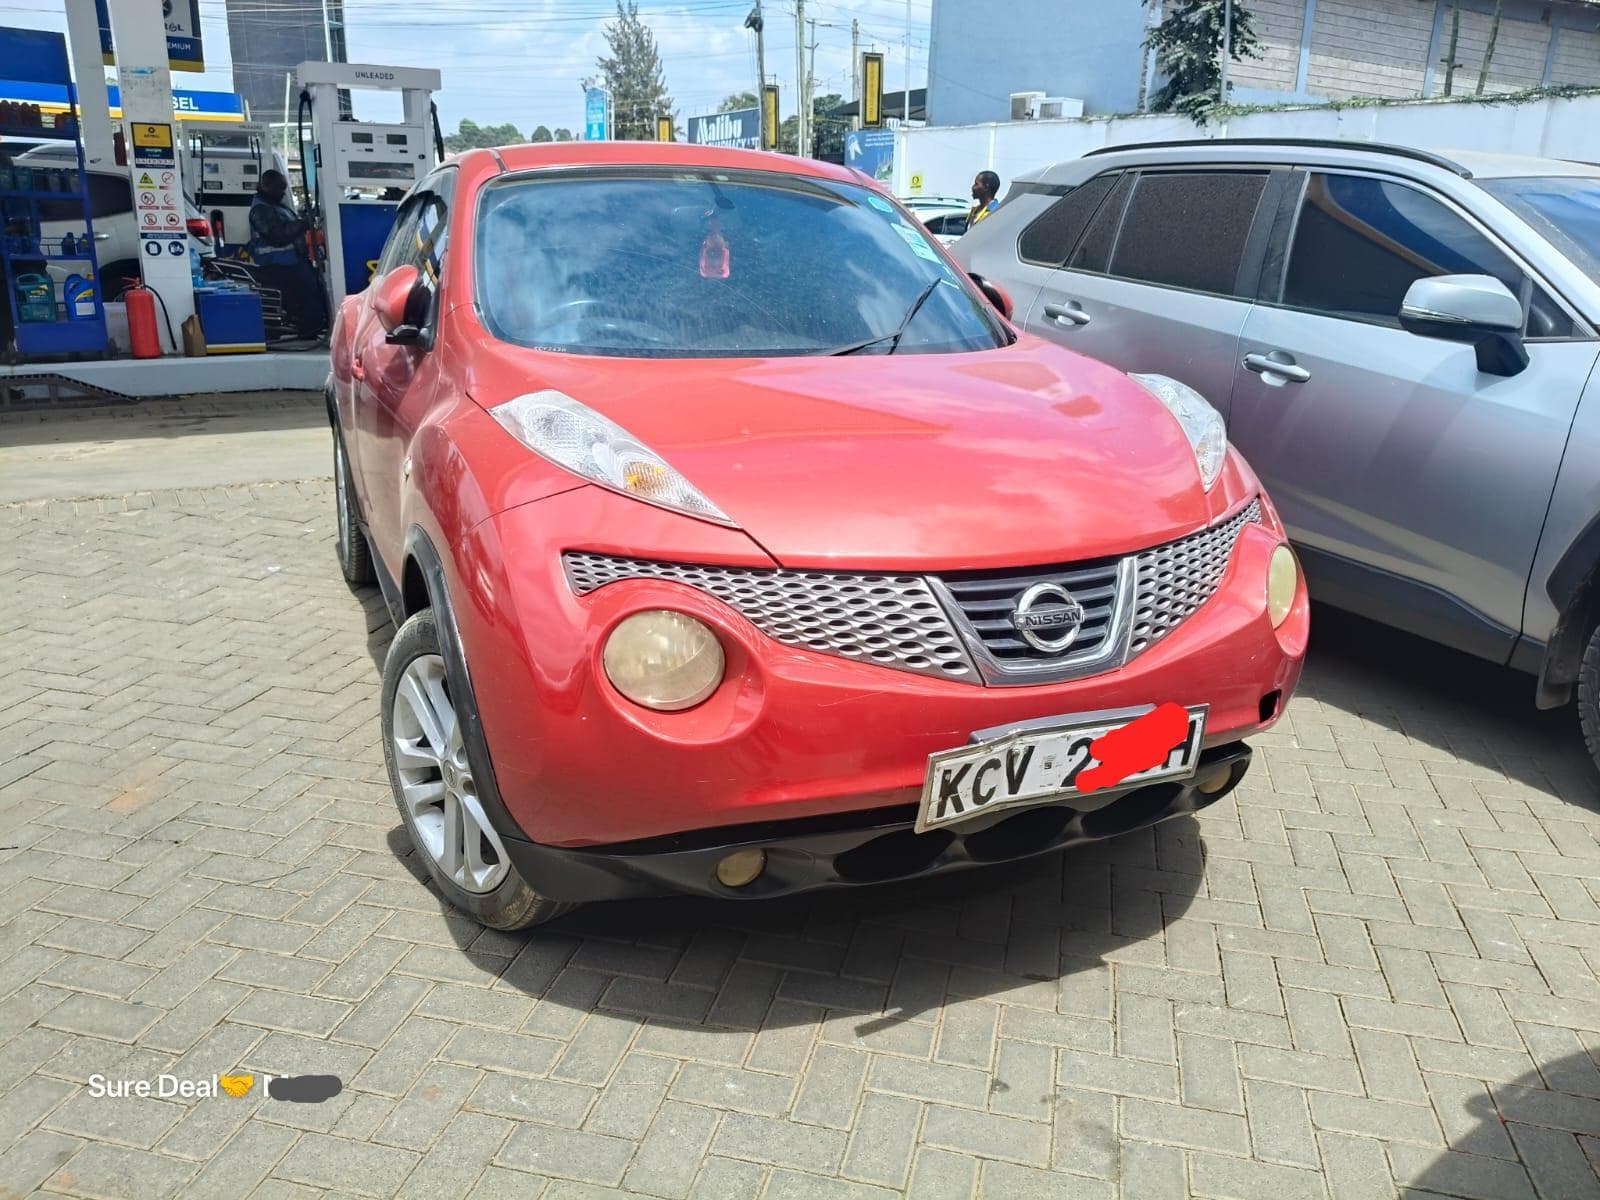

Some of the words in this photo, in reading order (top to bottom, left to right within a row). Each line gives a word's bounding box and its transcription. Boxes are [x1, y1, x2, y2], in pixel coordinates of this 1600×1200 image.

[355, 71, 395, 80] UNLEADED
[697, 114, 743, 145] Malibu
[1025, 611, 1080, 626] NISSAN
[936, 745, 1035, 818] KCV
[1060, 719, 1196, 787] 2H
